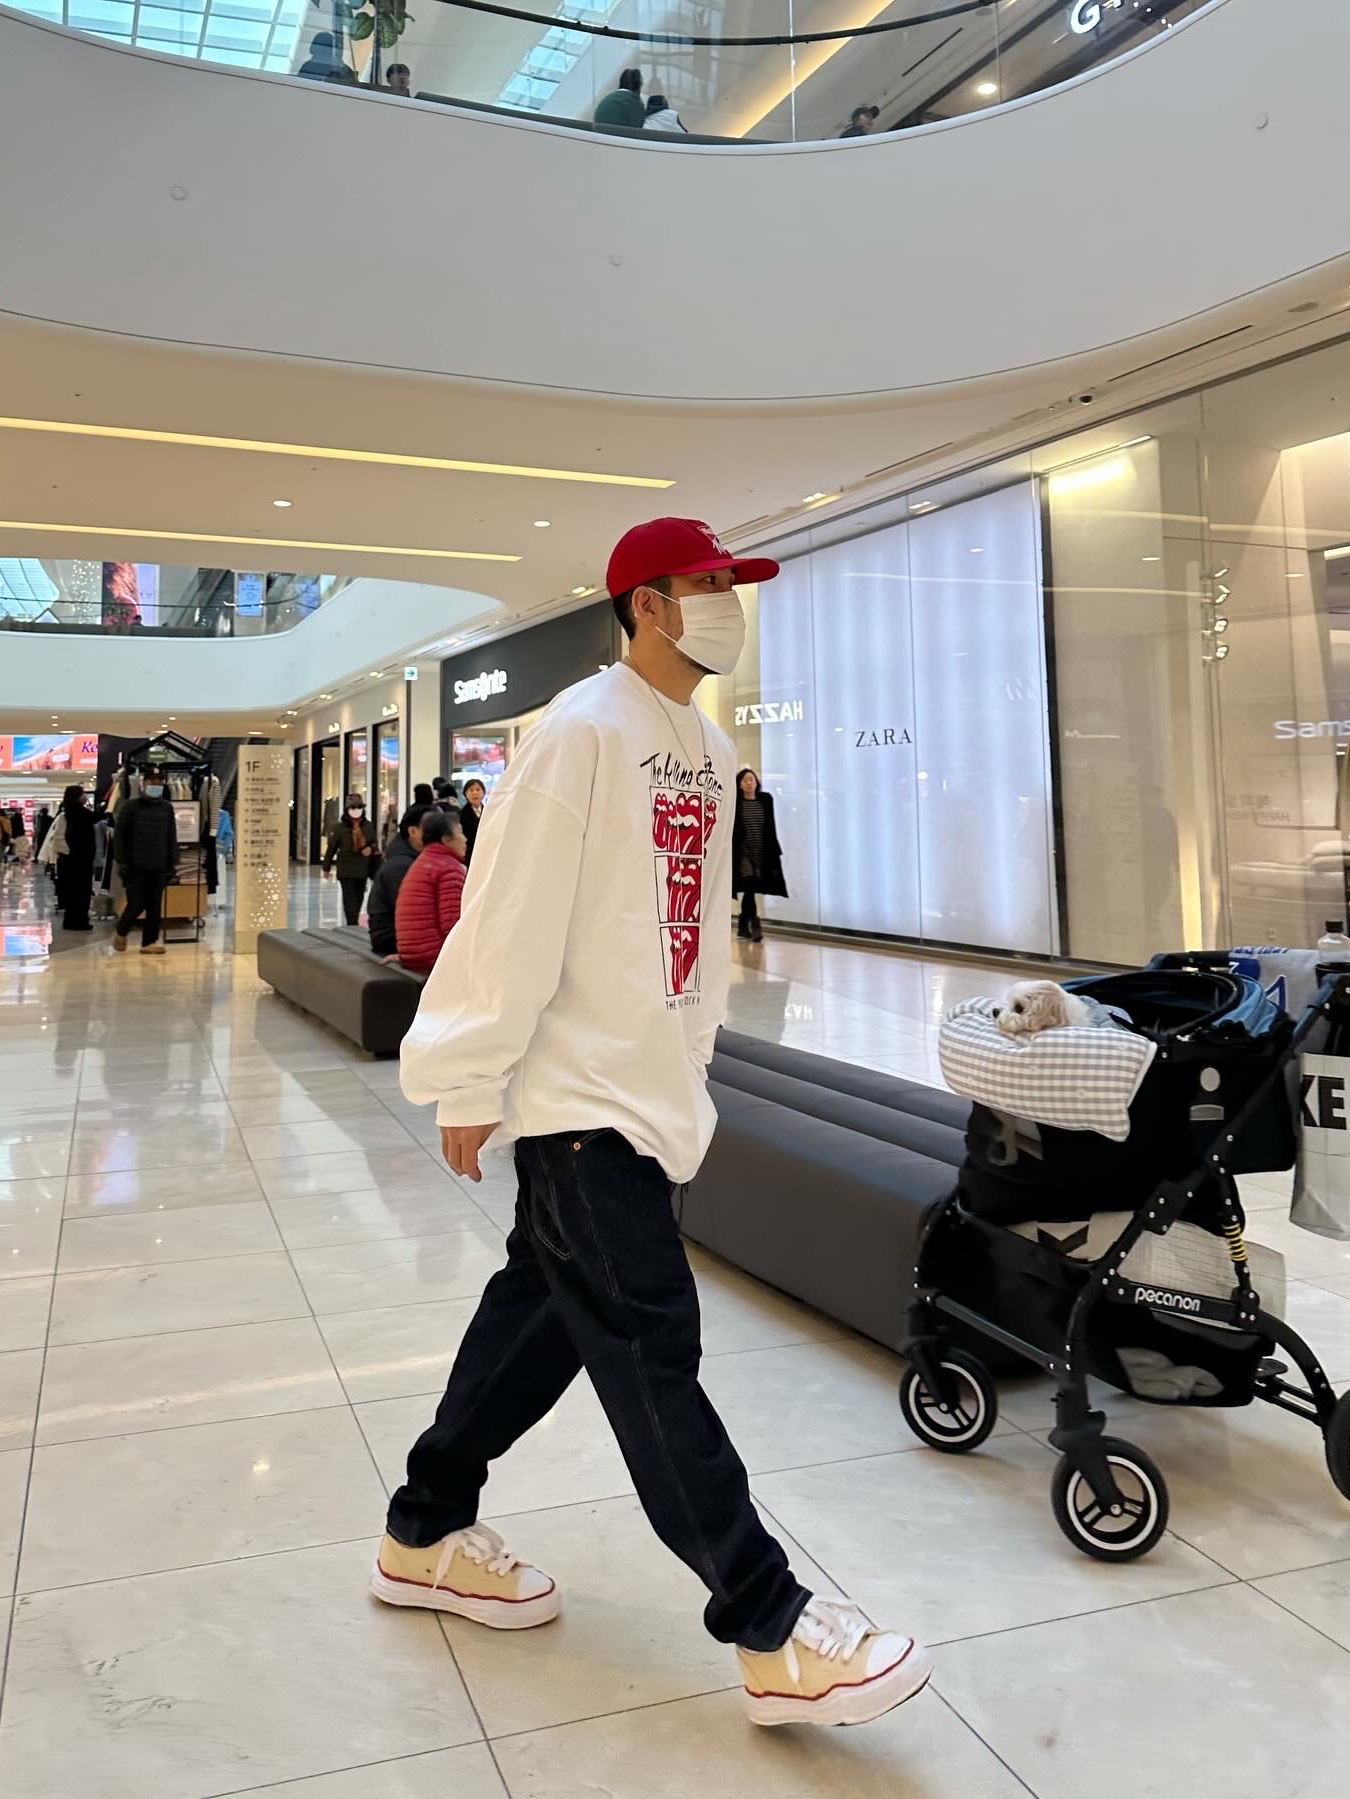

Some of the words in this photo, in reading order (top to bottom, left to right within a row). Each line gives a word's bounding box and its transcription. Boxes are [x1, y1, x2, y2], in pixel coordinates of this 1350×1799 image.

[856, 728, 912, 747] ZARA
[245, 760, 260, 773] 1F
[1301, 1074, 1347, 1130] KE
[1135, 1287, 1201, 1312] pecanon
